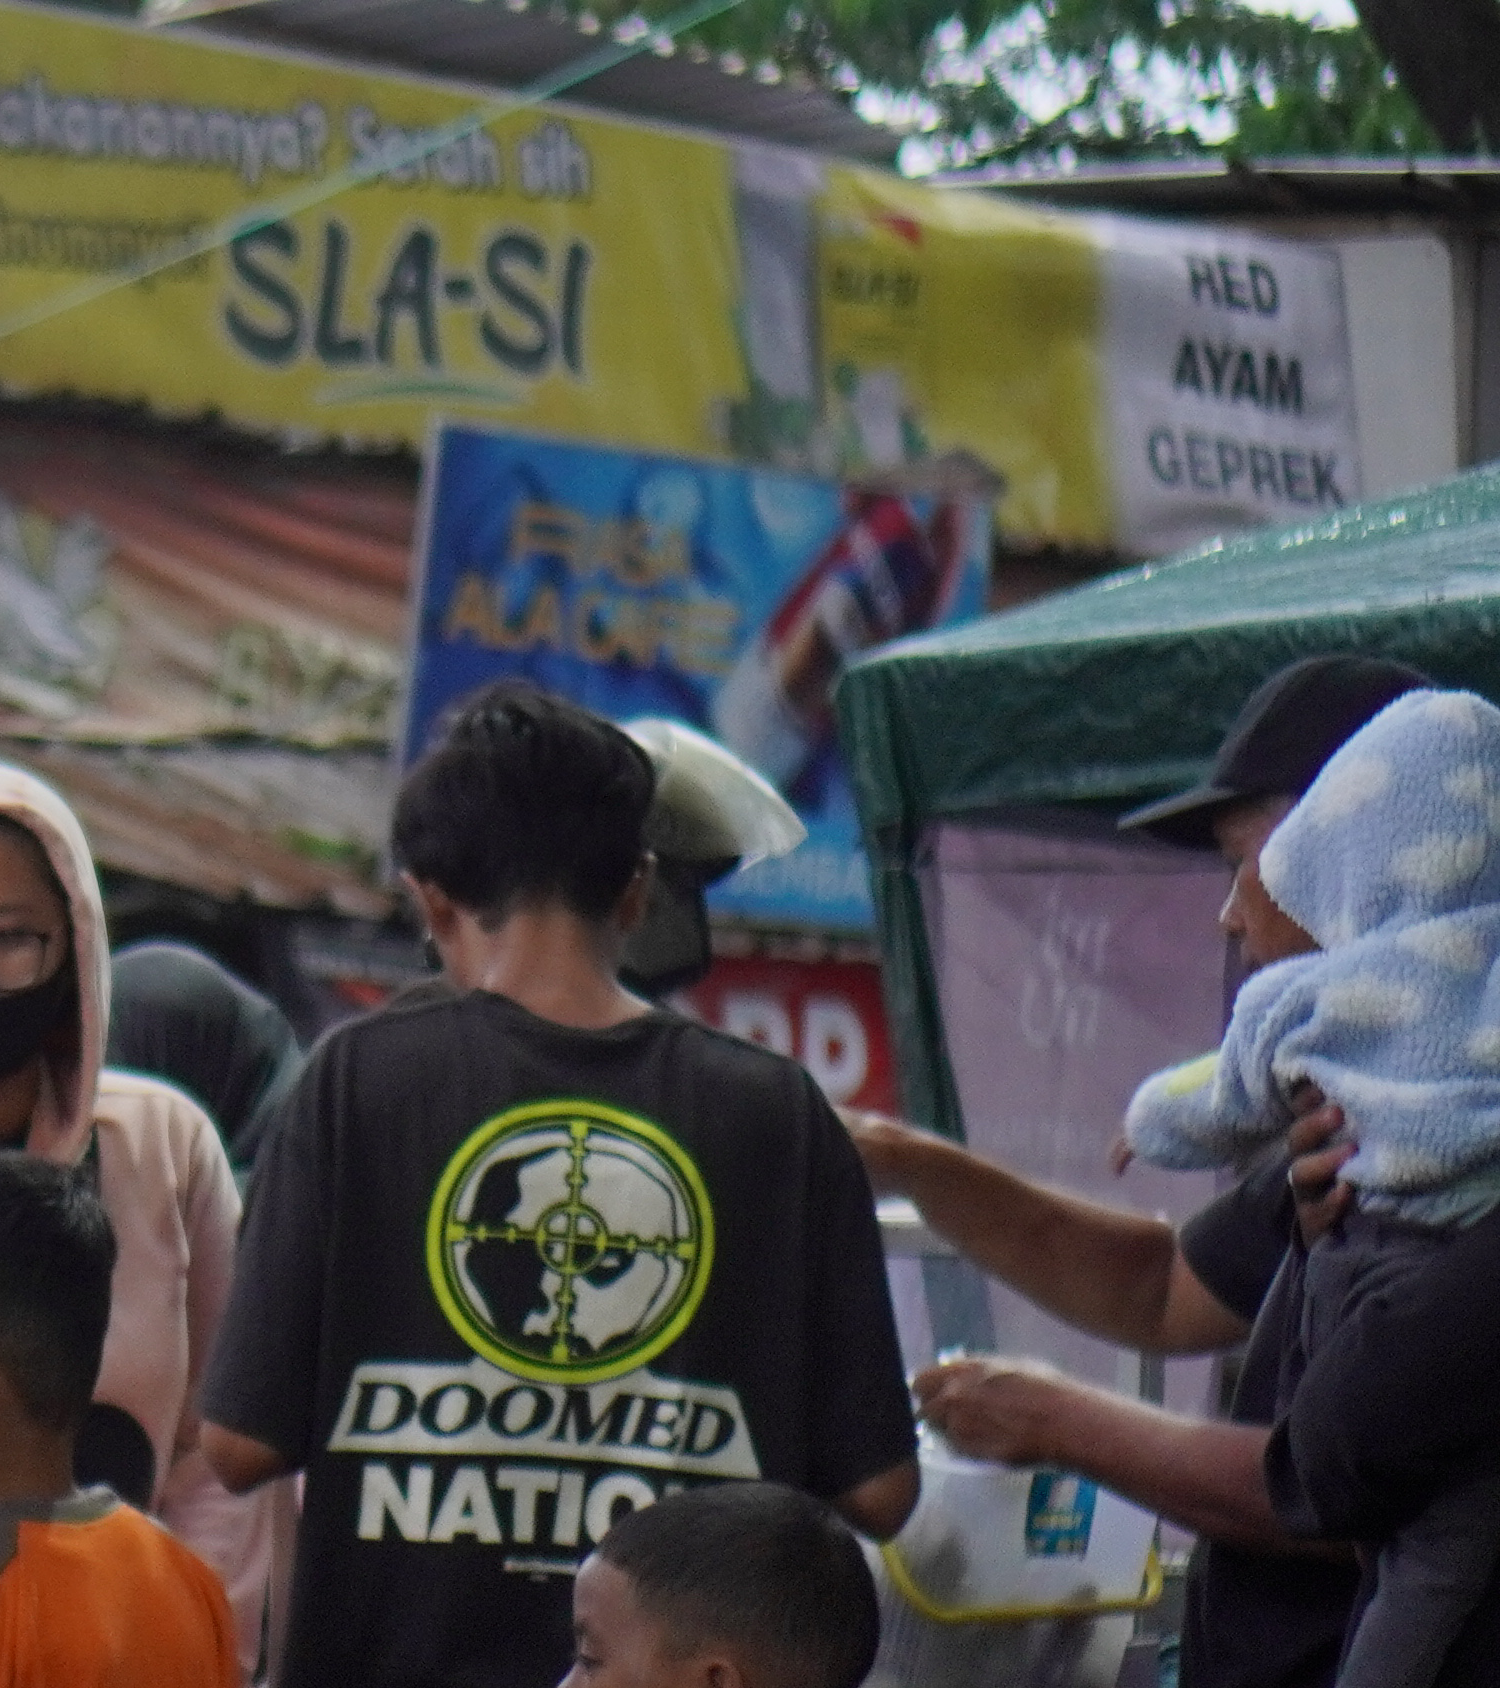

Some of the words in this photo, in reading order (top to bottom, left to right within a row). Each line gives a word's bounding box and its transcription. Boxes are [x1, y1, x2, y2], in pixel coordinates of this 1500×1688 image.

[224, 217, 592, 380] SLA-SI
[1172, 335, 1305, 415] AYAM
[1146, 425, 1345, 508] GEPREK
[347, 1380, 736, 1460] DOOMED
[356, 1461, 688, 1546] NATIO
